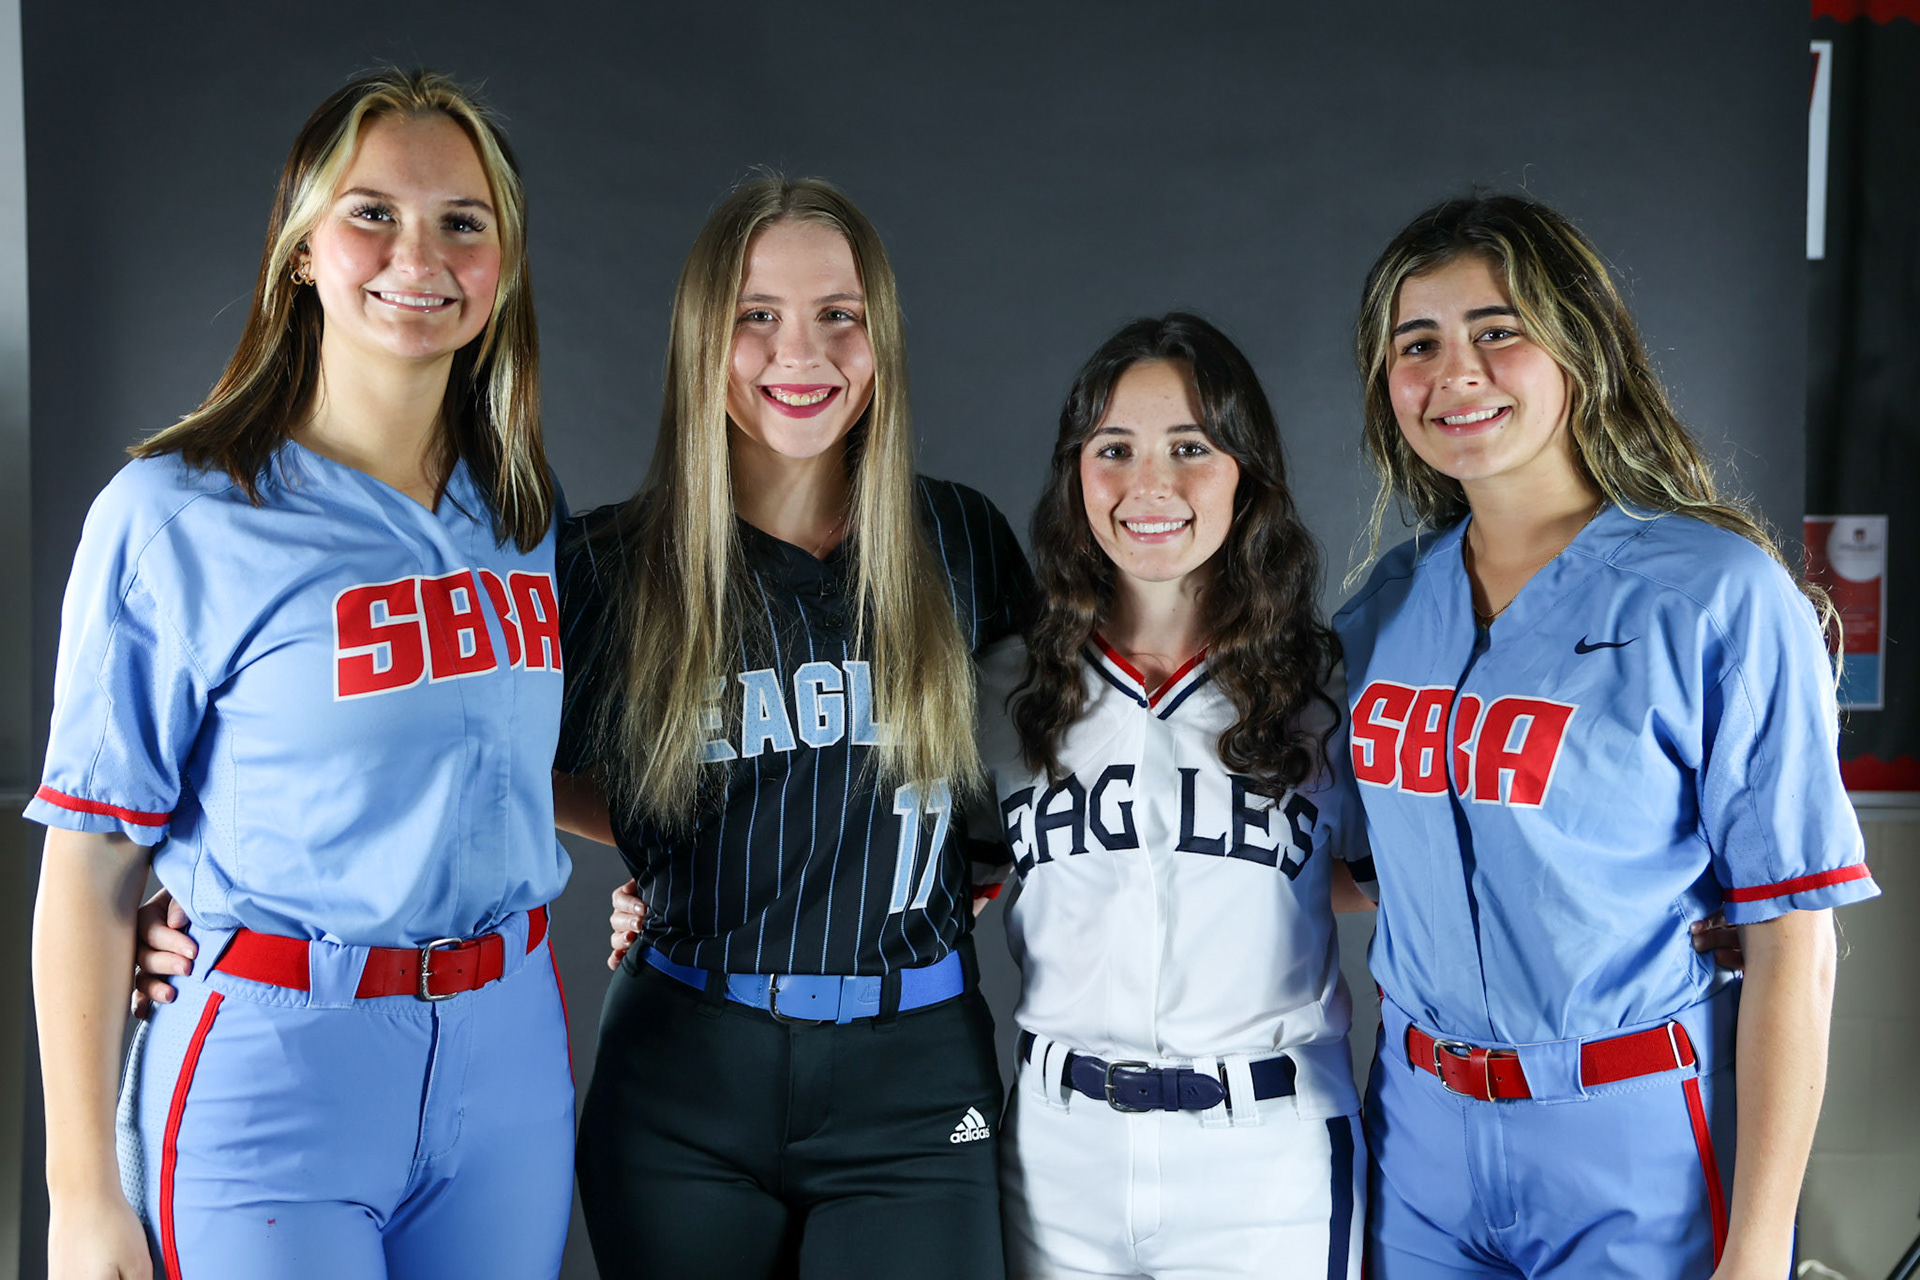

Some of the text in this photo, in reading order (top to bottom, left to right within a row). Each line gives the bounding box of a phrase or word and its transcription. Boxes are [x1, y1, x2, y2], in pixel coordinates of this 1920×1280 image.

[332, 567, 563, 702] SBA
[694, 661, 904, 764] EAGL
[1350, 679, 1580, 810] SBA
[888, 776, 952, 915] 17
[1000, 764, 1319, 882] EAGLES
[949, 1127, 990, 1144] adidas
